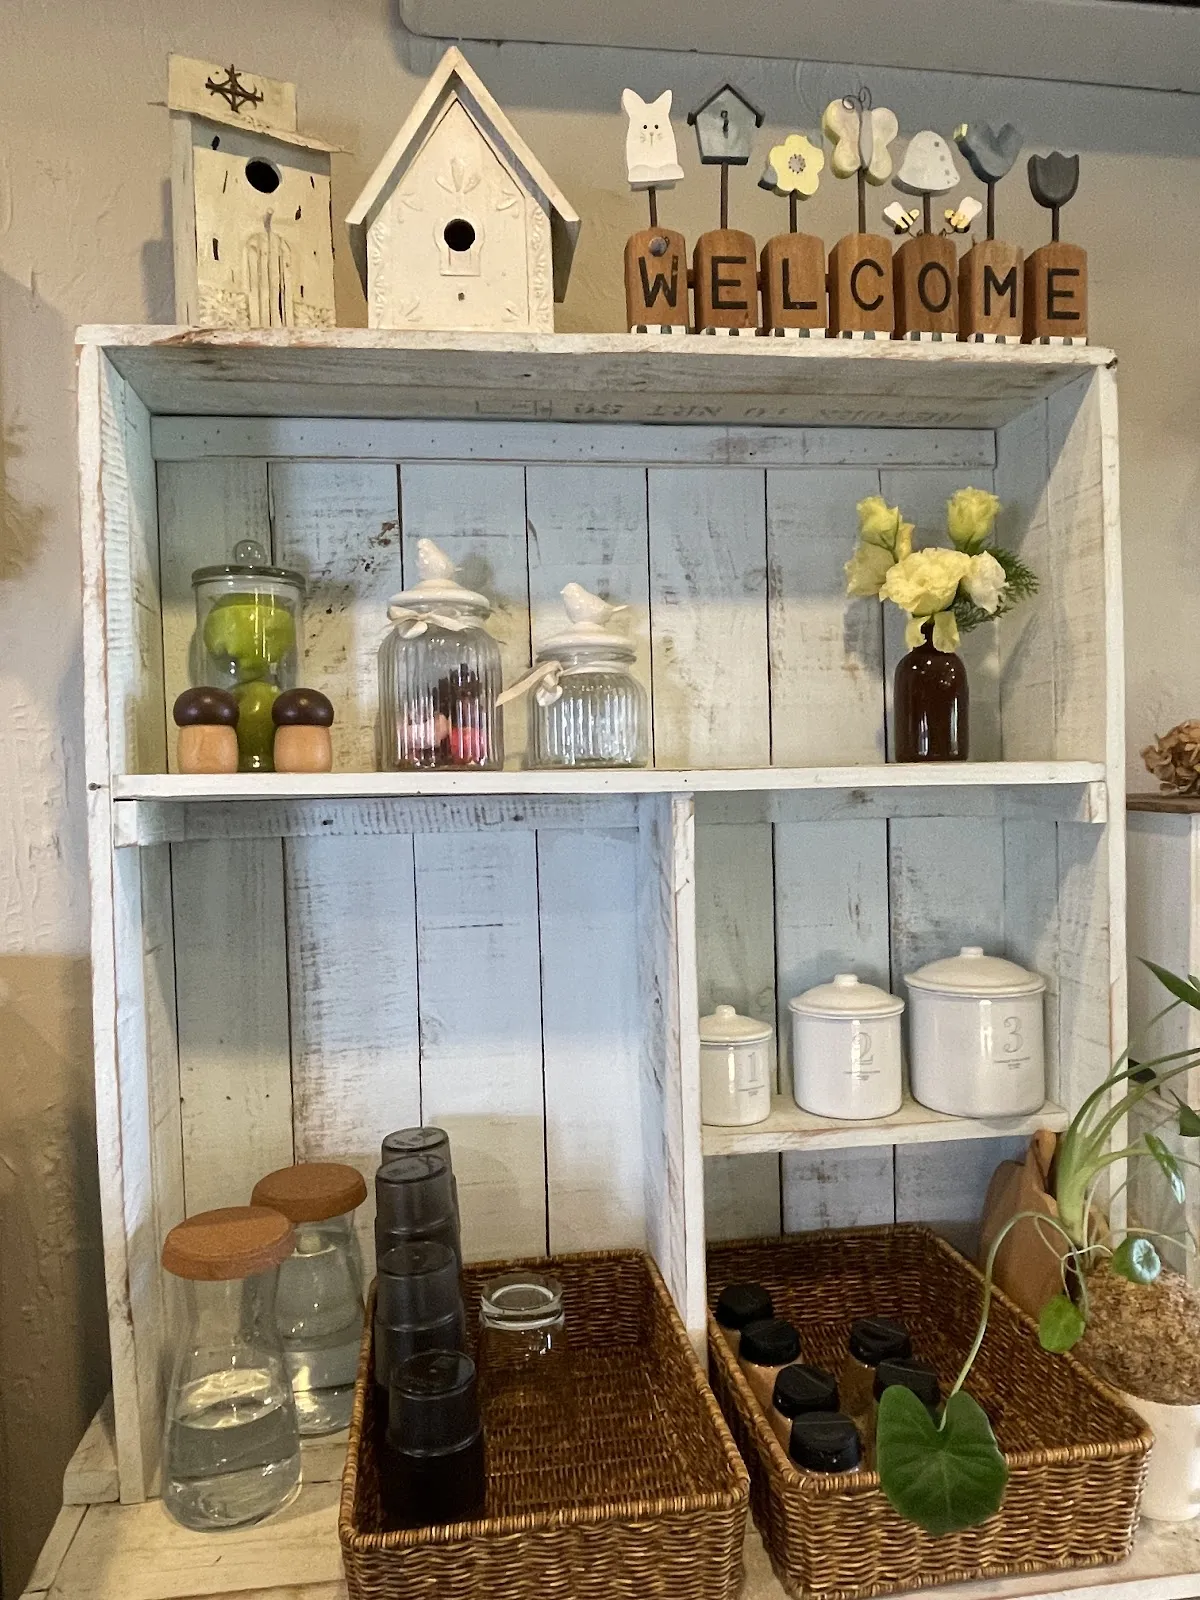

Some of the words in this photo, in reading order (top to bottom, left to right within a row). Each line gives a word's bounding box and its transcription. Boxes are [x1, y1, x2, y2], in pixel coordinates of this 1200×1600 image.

[638, 255, 1081, 321] WELCOME
[852, 1031, 874, 1066] 2
[1003, 1016, 1025, 1053] 3
[747, 1051, 759, 1083] 1
